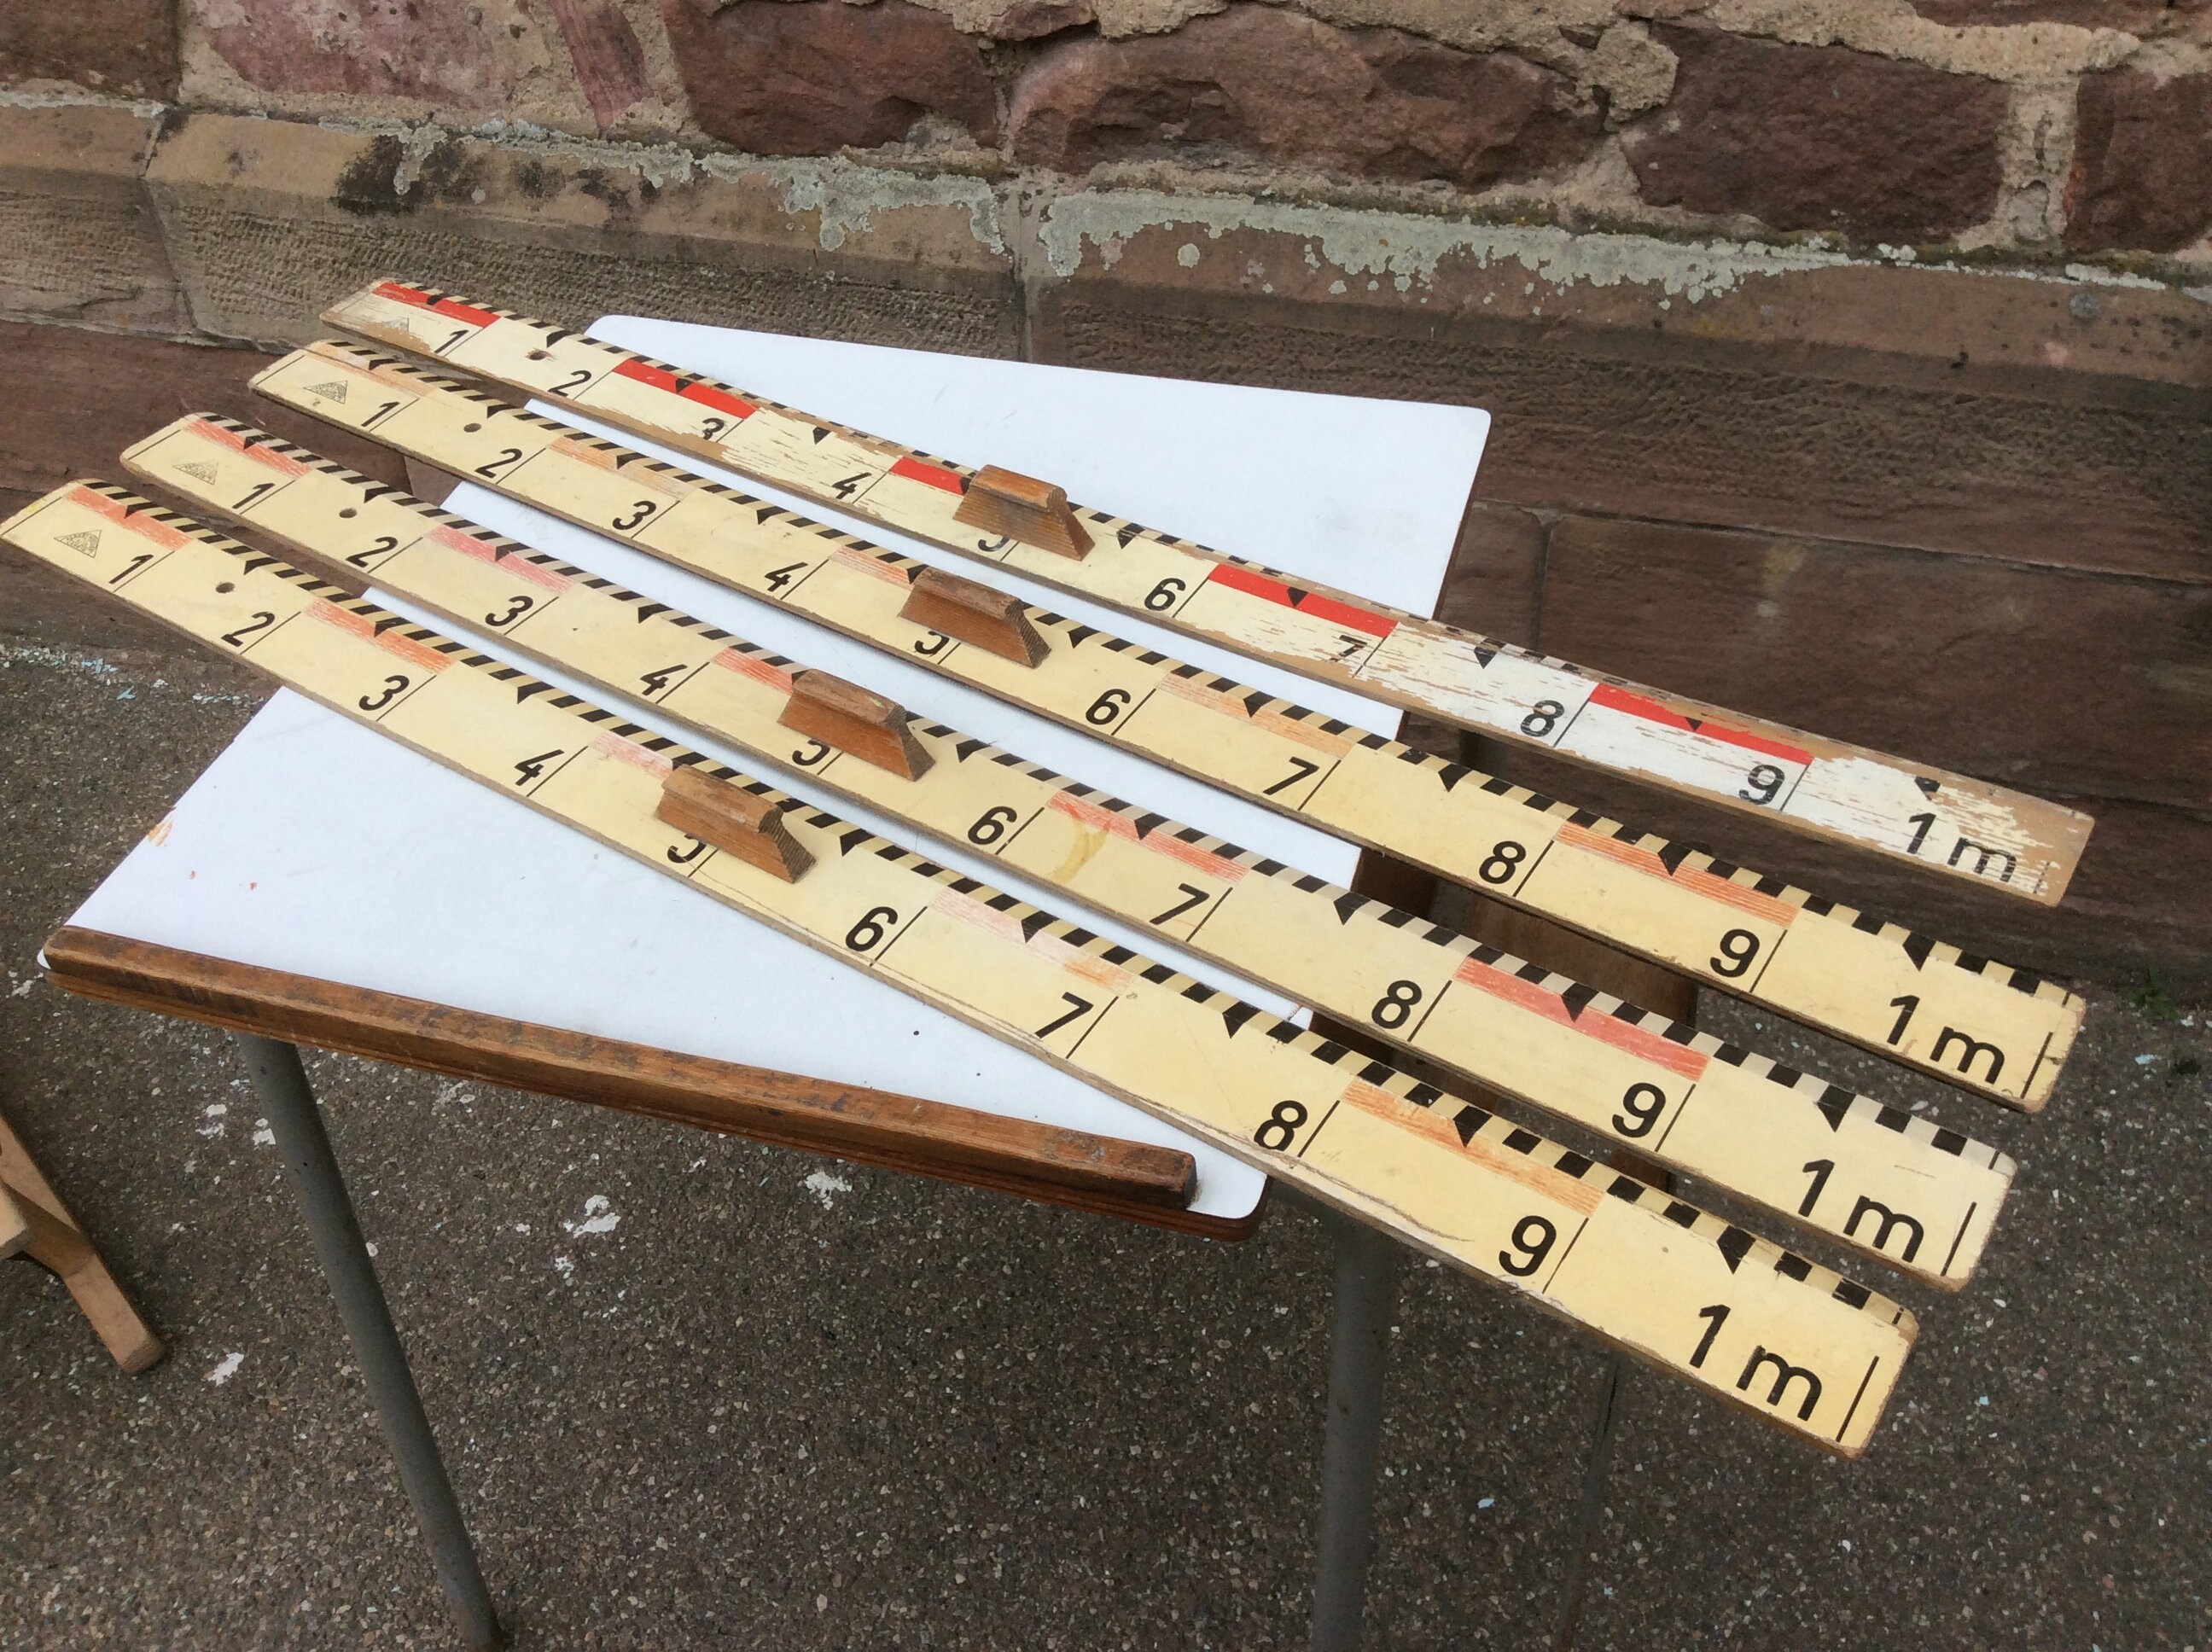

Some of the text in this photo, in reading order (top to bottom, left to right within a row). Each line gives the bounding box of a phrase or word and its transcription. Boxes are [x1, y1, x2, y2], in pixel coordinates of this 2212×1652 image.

[232, 483, 275, 509] 1
[346, 537, 398, 567] 2
[486, 596, 533, 626] 3
[640, 665, 687, 695] 4
[968, 806, 1017, 845] 6
[1150, 883, 1209, 925] 7
[1371, 980, 1422, 1029] 8
[1612, 1083, 1666, 1137] 9
[361, 402, 399, 427] 1
[474, 449, 522, 478] 2
[613, 501, 656, 530] 3
[765, 562, 808, 591] 4
[1086, 689, 1131, 724] 6
[1263, 757, 1319, 795] 7
[1479, 841, 1526, 884] 8
[1710, 929, 1760, 977] 9
[434, 330, 469, 353] 1
[548, 370, 591, 397] 2
[702, 418, 725, 440] 3
[832, 473, 871, 499] 4
[1144, 579, 1185, 611] 6
[1330, 635, 1367, 662] 7
[1521, 701, 1564, 737] 8
[1739, 765, 1784, 805] 9
[109, 555, 154, 584] 1
[221, 612, 275, 647] 2
[359, 675, 409, 711] 3
[515, 750, 564, 786] 4
[846, 907, 898, 951] 6
[1035, 992, 1093, 1038] 7
[1254, 1101, 1307, 1151] 8
[1499, 1216, 1557, 1277] 9
